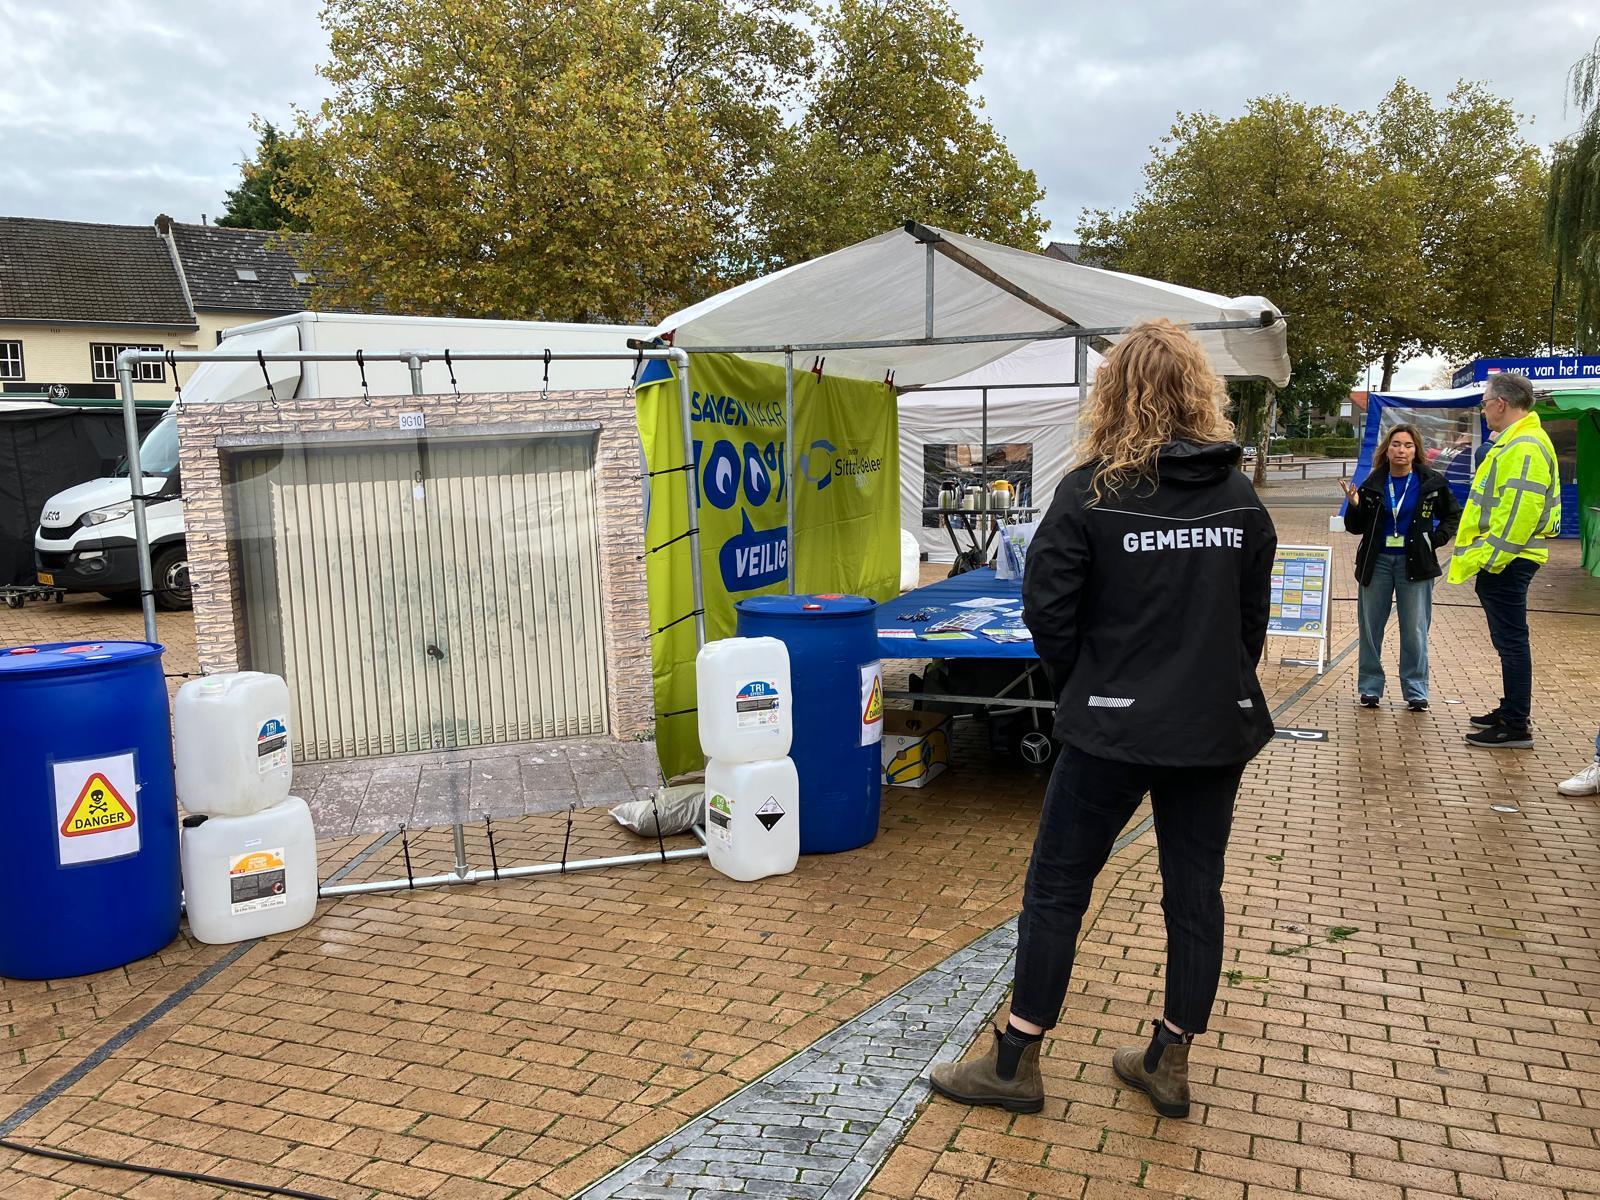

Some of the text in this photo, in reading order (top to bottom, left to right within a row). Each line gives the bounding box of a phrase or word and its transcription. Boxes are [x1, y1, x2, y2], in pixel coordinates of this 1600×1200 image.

[1534, 366, 1555, 376] van
[1559, 360, 1579, 376] het
[401, 415, 423, 428] 9G10
[1123, 526, 1244, 553] GEMEENTE
[735, 539, 788, 578] VEILIG
[749, 683, 765, 693] TRI
[266, 721, 277, 733] TRI
[75, 811, 125, 829] DANGER
